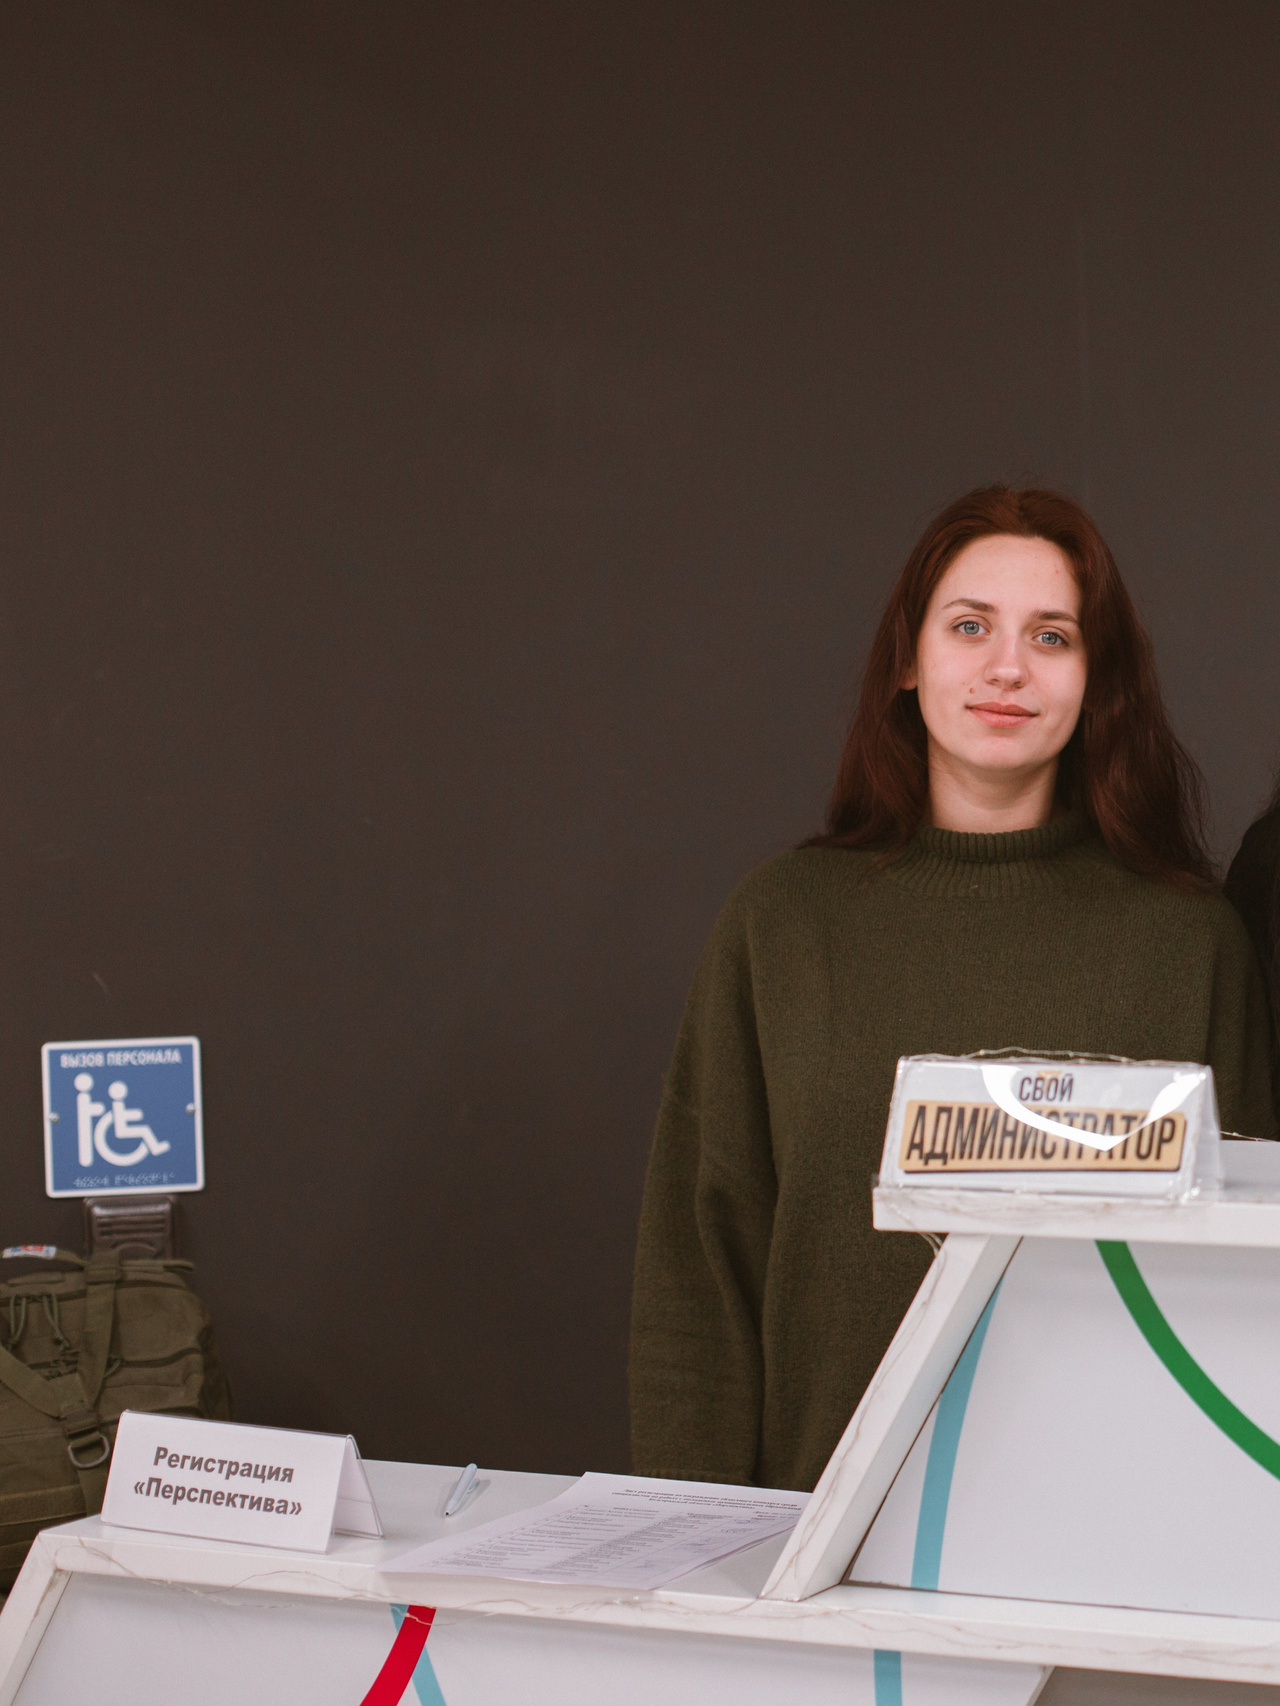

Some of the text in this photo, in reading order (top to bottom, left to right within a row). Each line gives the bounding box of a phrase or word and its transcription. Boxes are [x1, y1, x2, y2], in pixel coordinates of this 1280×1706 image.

[60, 1049, 182, 1068] ВЫЗОВ ПЕРСОНАЛА
[1019, 1073, 1074, 1102] СВОЙ
[153, 1446, 295, 1483] Регистрация
[133, 1476, 303, 1516] «Перспектива»
